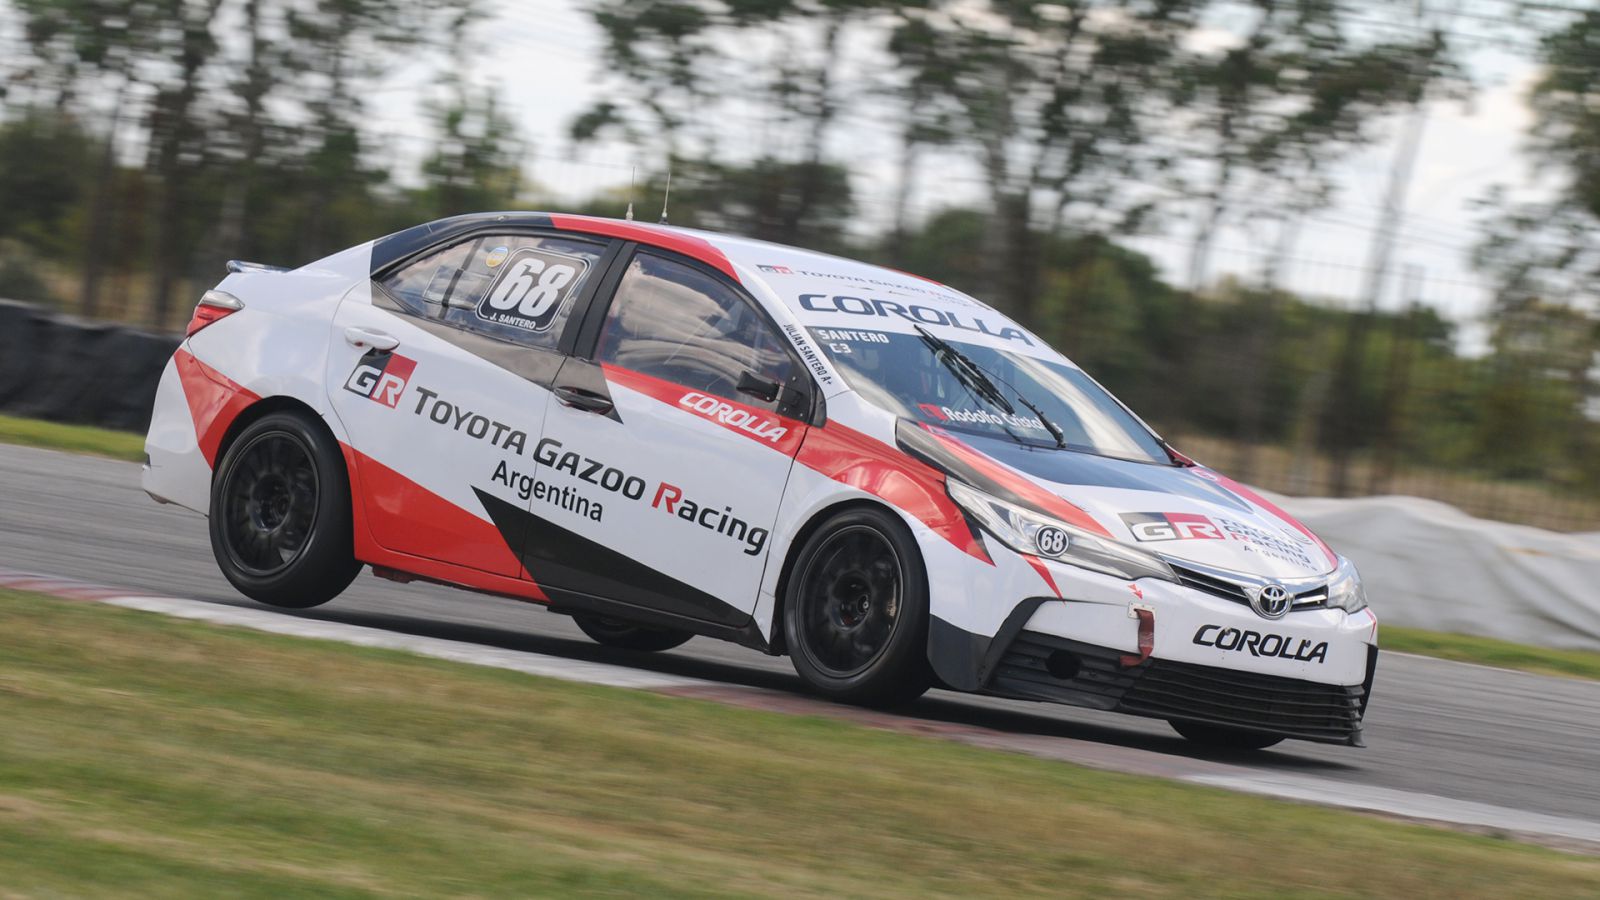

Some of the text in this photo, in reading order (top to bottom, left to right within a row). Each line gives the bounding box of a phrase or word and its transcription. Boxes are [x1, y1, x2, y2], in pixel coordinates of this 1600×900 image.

[490, 258, 575, 317] 68
[490, 313, 537, 329] J. SANTERO
[798, 294, 1035, 347] COROLLA
[817, 329, 890, 344] SANTERO
[783, 323, 807, 346] JULIAN
[800, 346, 828, 376] SANTERO
[678, 392, 788, 443] COROLLA
[941, 406, 1003, 425] Rodolfo
[346, 363, 769, 556] GR TOYOTA GAZOO Racing
[491, 460, 604, 523] Argentina
[1040, 528, 1065, 553] 68
[1131, 520, 1224, 541] GR
[1192, 623, 1328, 664] COROLLA
